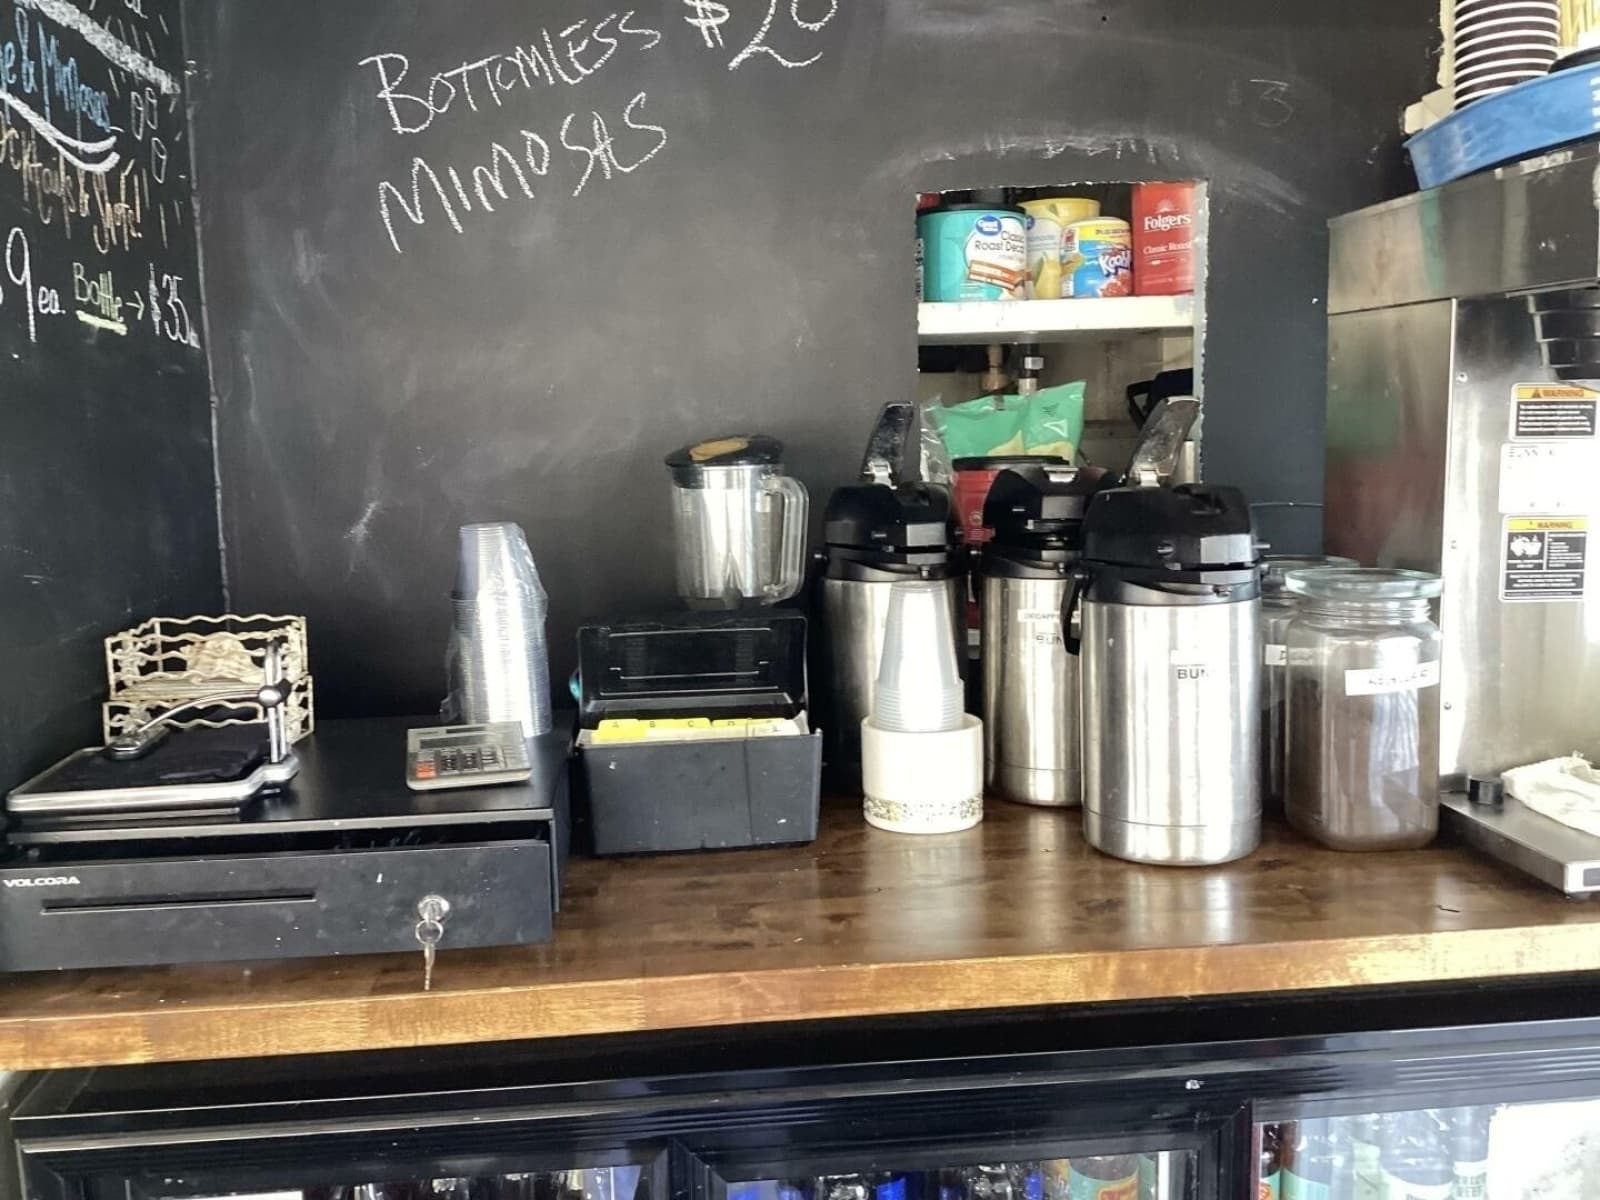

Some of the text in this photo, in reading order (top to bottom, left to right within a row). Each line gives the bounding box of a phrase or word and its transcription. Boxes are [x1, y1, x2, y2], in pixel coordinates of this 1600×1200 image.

[377, 92, 667, 253] MIMOSAS
[1142, 214, 1192, 232] Folgers
[975, 240, 1003, 252] Roast
[72, 262, 124, 322] Bottle
[2, 876, 80, 888] VOLCORA
